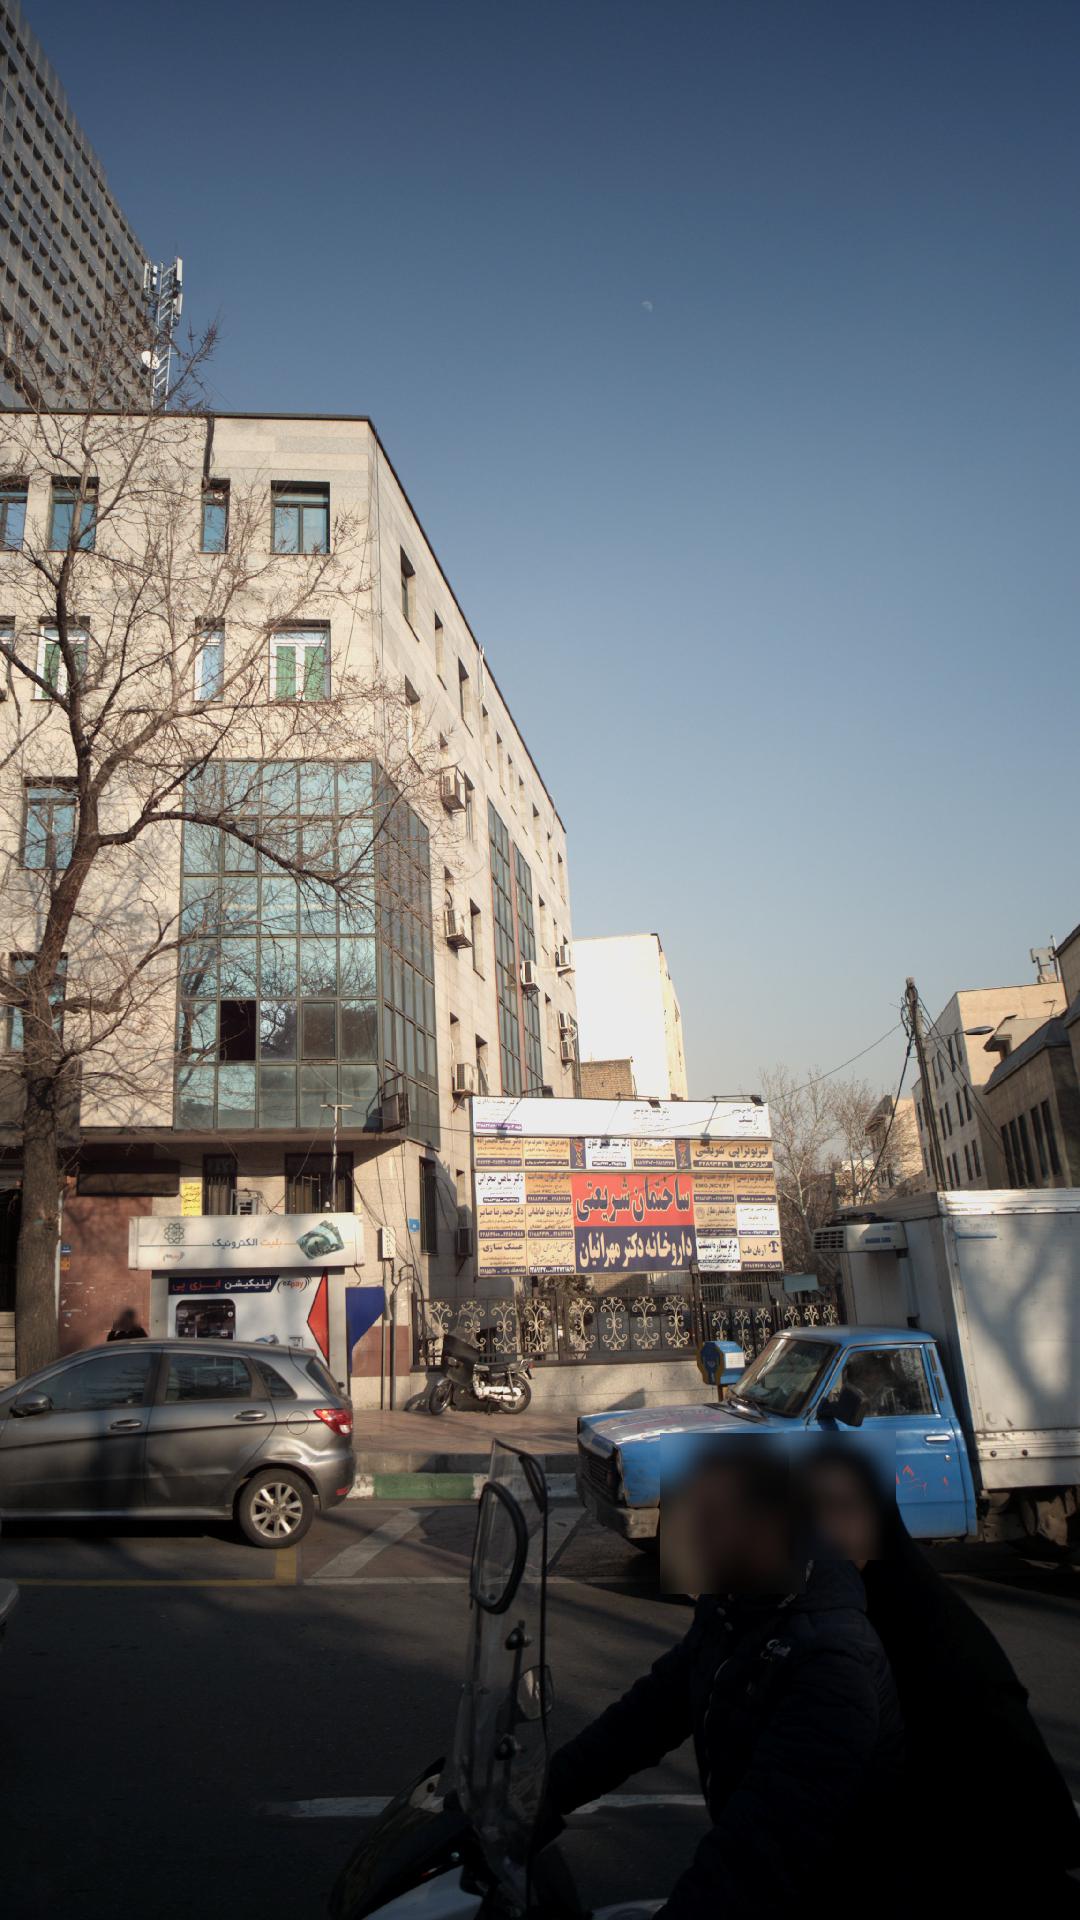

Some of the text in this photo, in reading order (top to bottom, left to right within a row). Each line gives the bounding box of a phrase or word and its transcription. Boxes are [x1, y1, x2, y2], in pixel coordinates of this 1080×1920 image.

[576, 1175, 691, 1222] ساختمان شریعتی
[212, 1238, 258, 1250] الکترونیک
[482, 1241, 523, 1253] عینک سازی
[622, 1231, 645, 1268] دکتر
[645, 1231, 693, 1267] داروخانه
[172, 1282, 186, 1292] پی
[225, 1279, 272, 1290] اپلیکیشن
